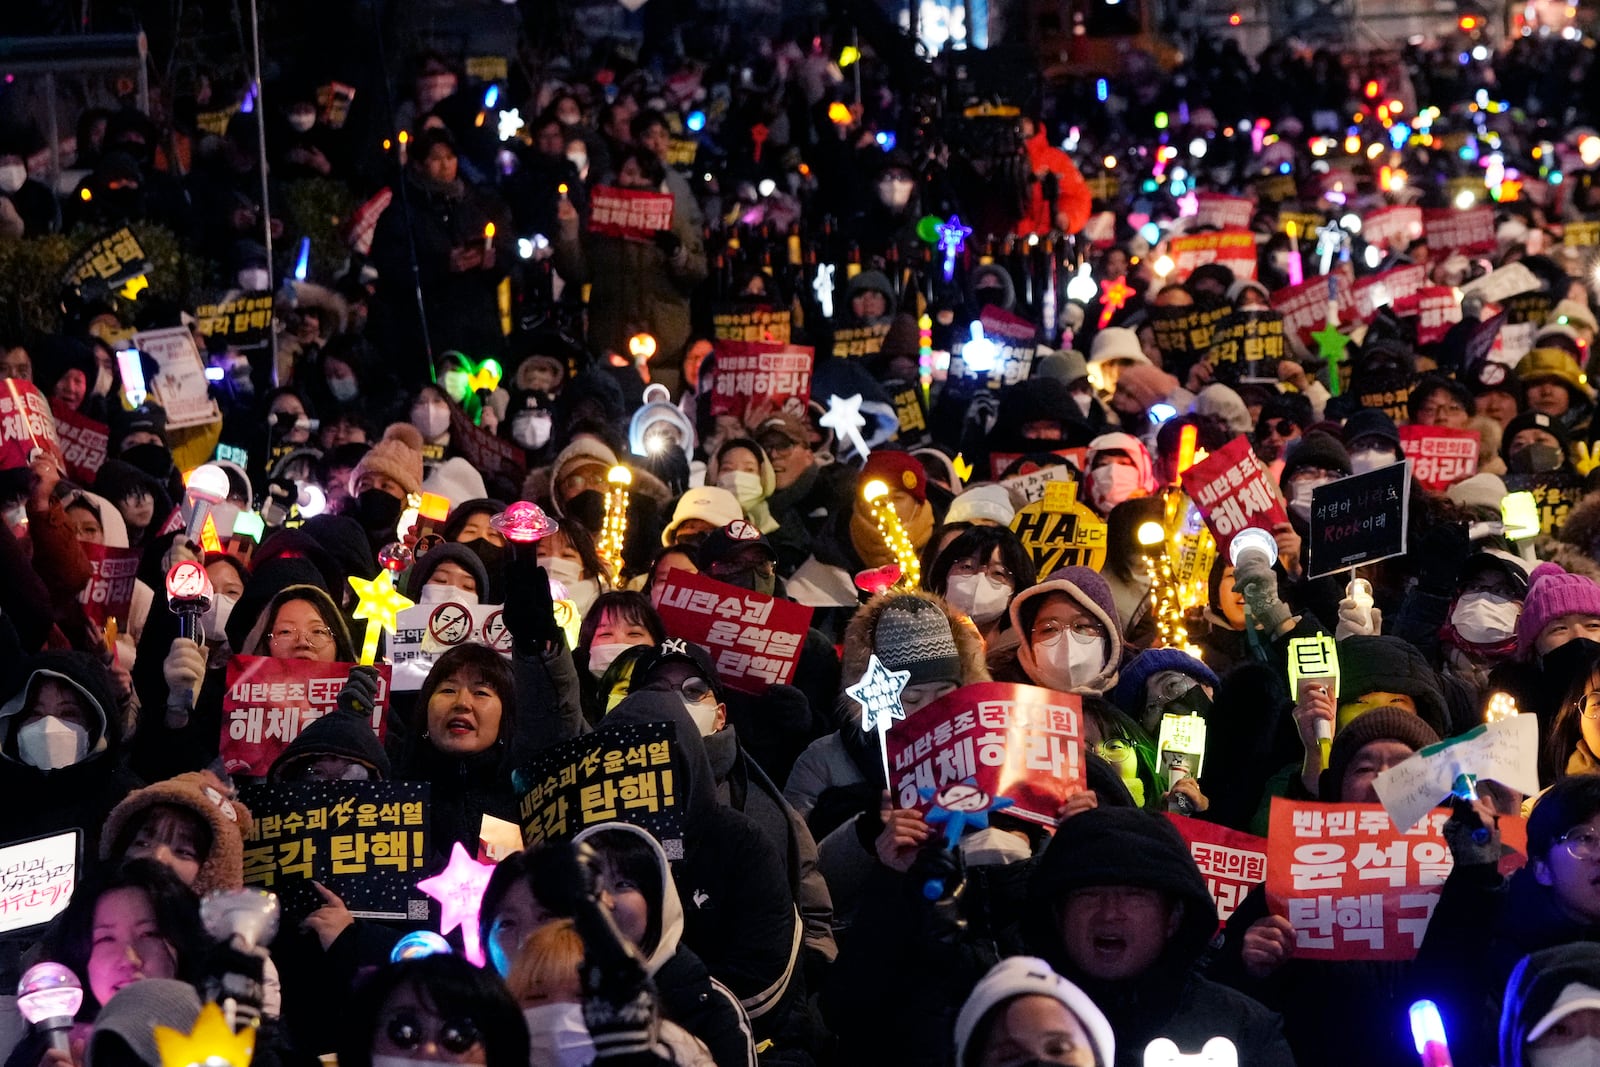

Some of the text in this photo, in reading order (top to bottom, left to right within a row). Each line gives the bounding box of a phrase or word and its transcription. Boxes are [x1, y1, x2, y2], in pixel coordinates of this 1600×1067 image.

[716, 371, 809, 397] 해체하라!
[1198, 455, 1257, 507] 내란동조
[1316, 497, 1351, 520] 석열아
[1014, 512, 1079, 545] HA
[660, 584, 774, 626] 내란수괴
[660, 637, 688, 655] NY
[706, 619, 802, 657] 윤석열
[716, 651, 793, 684] 탄핵!
[1296, 641, 1330, 674] 탄
[232, 682, 305, 703] 내란동조
[895, 711, 976, 772] 내란동조
[520, 739, 671, 820] 내란수괴 윤석열
[579, 768, 675, 825] 탄핵!
[355, 801, 424, 828] 윤석열
[1291, 809, 1389, 838] 반민주
[243, 830, 424, 887] 즉각 탄핵!
[1192, 846, 1265, 881] 국민의힘
[1289, 840, 1452, 891] 윤석열
[1287, 894, 1385, 951] 탄핵
